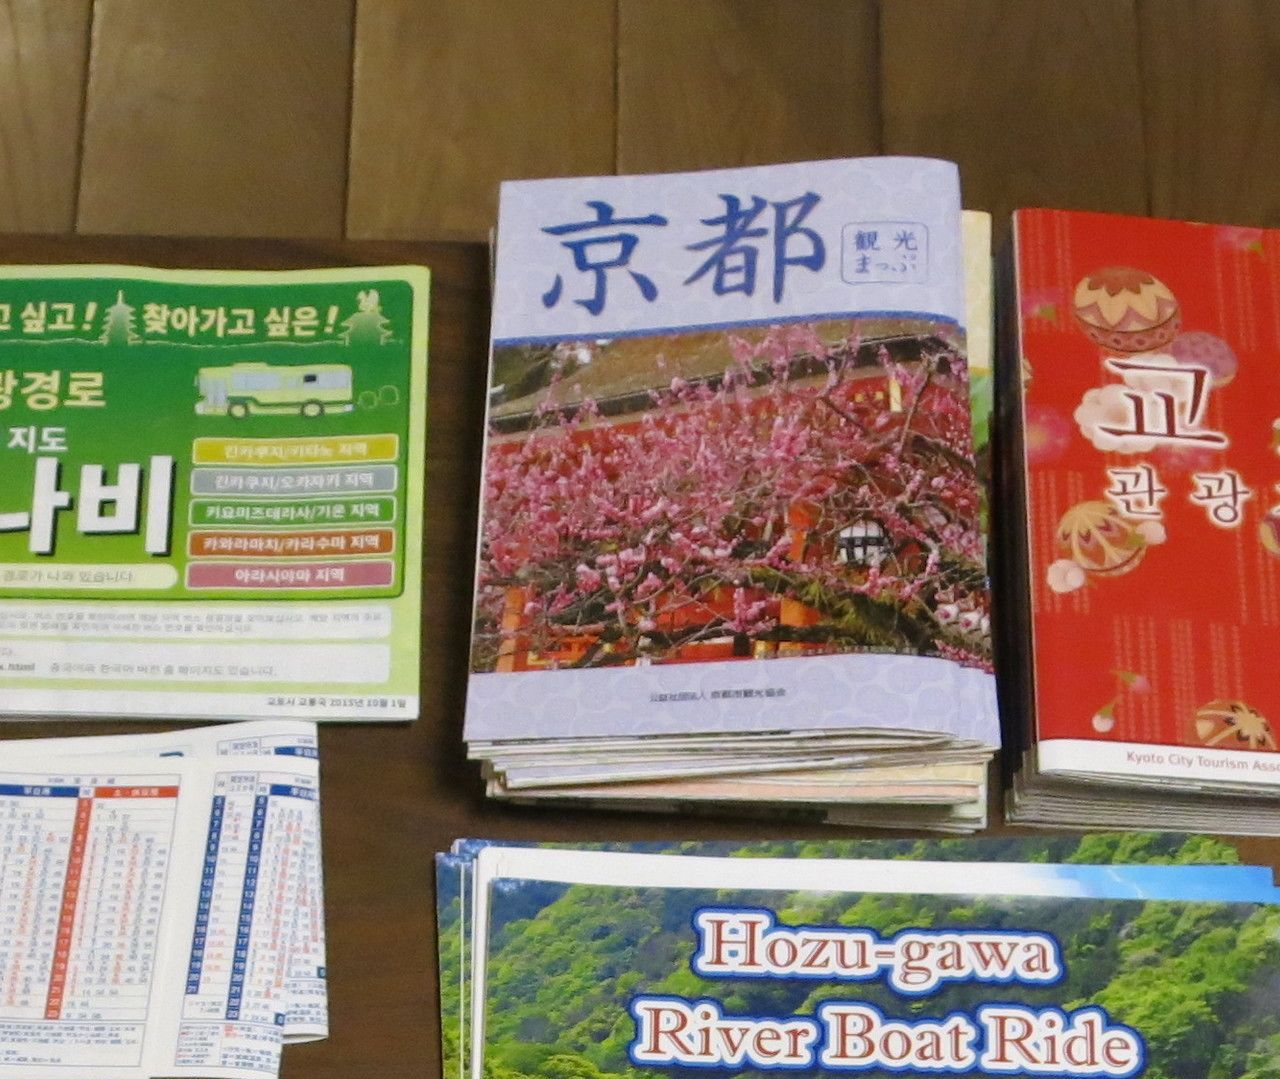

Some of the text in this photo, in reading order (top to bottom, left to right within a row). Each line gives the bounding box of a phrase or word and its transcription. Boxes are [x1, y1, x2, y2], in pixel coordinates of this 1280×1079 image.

[541, 192, 826, 315] 京都
[854, 230, 920, 252] 観光
[854, 255, 920, 275] まっぷ
[20, 301, 95, 335] 싶고!
[142, 304, 256, 338] 찾아가고
[264, 304, 340, 338] 싶은!
[9, 426, 68, 454] 지도
[1127, 752, 1164, 766] Kyoto
[1168, 754, 1193, 768] City
[1198, 756, 1248, 769] Tourism
[705, 917, 1053, 985] Hozu-gawa
[644, 1005, 1132, 1069] River Boat Ride
